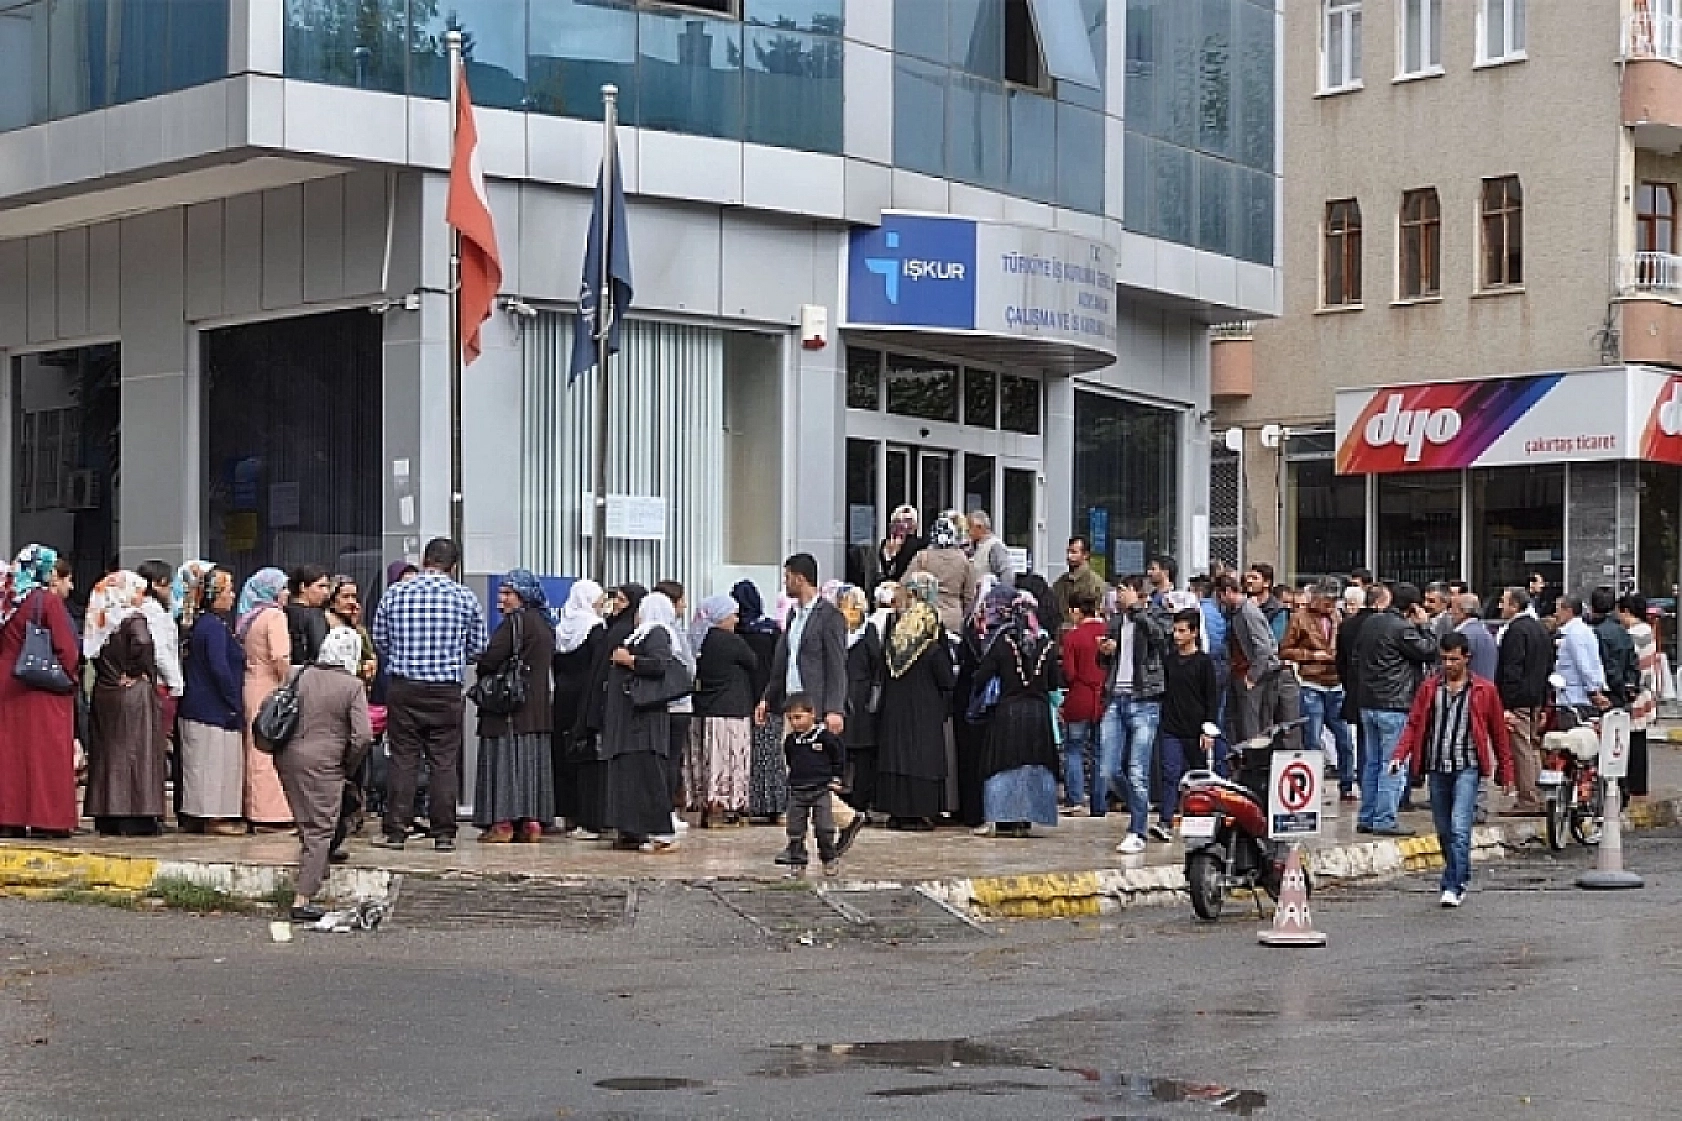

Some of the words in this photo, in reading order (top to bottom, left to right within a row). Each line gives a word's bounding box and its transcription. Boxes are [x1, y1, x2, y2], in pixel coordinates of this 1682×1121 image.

[902, 257, 966, 281] İŞKUR
[1002, 251, 1051, 276] TÜRKİYE
[1005, 305, 1055, 331] ÇALIŞMA
[1364, 393, 1461, 462] dyo
[1576, 434, 1616, 450] ticaret
